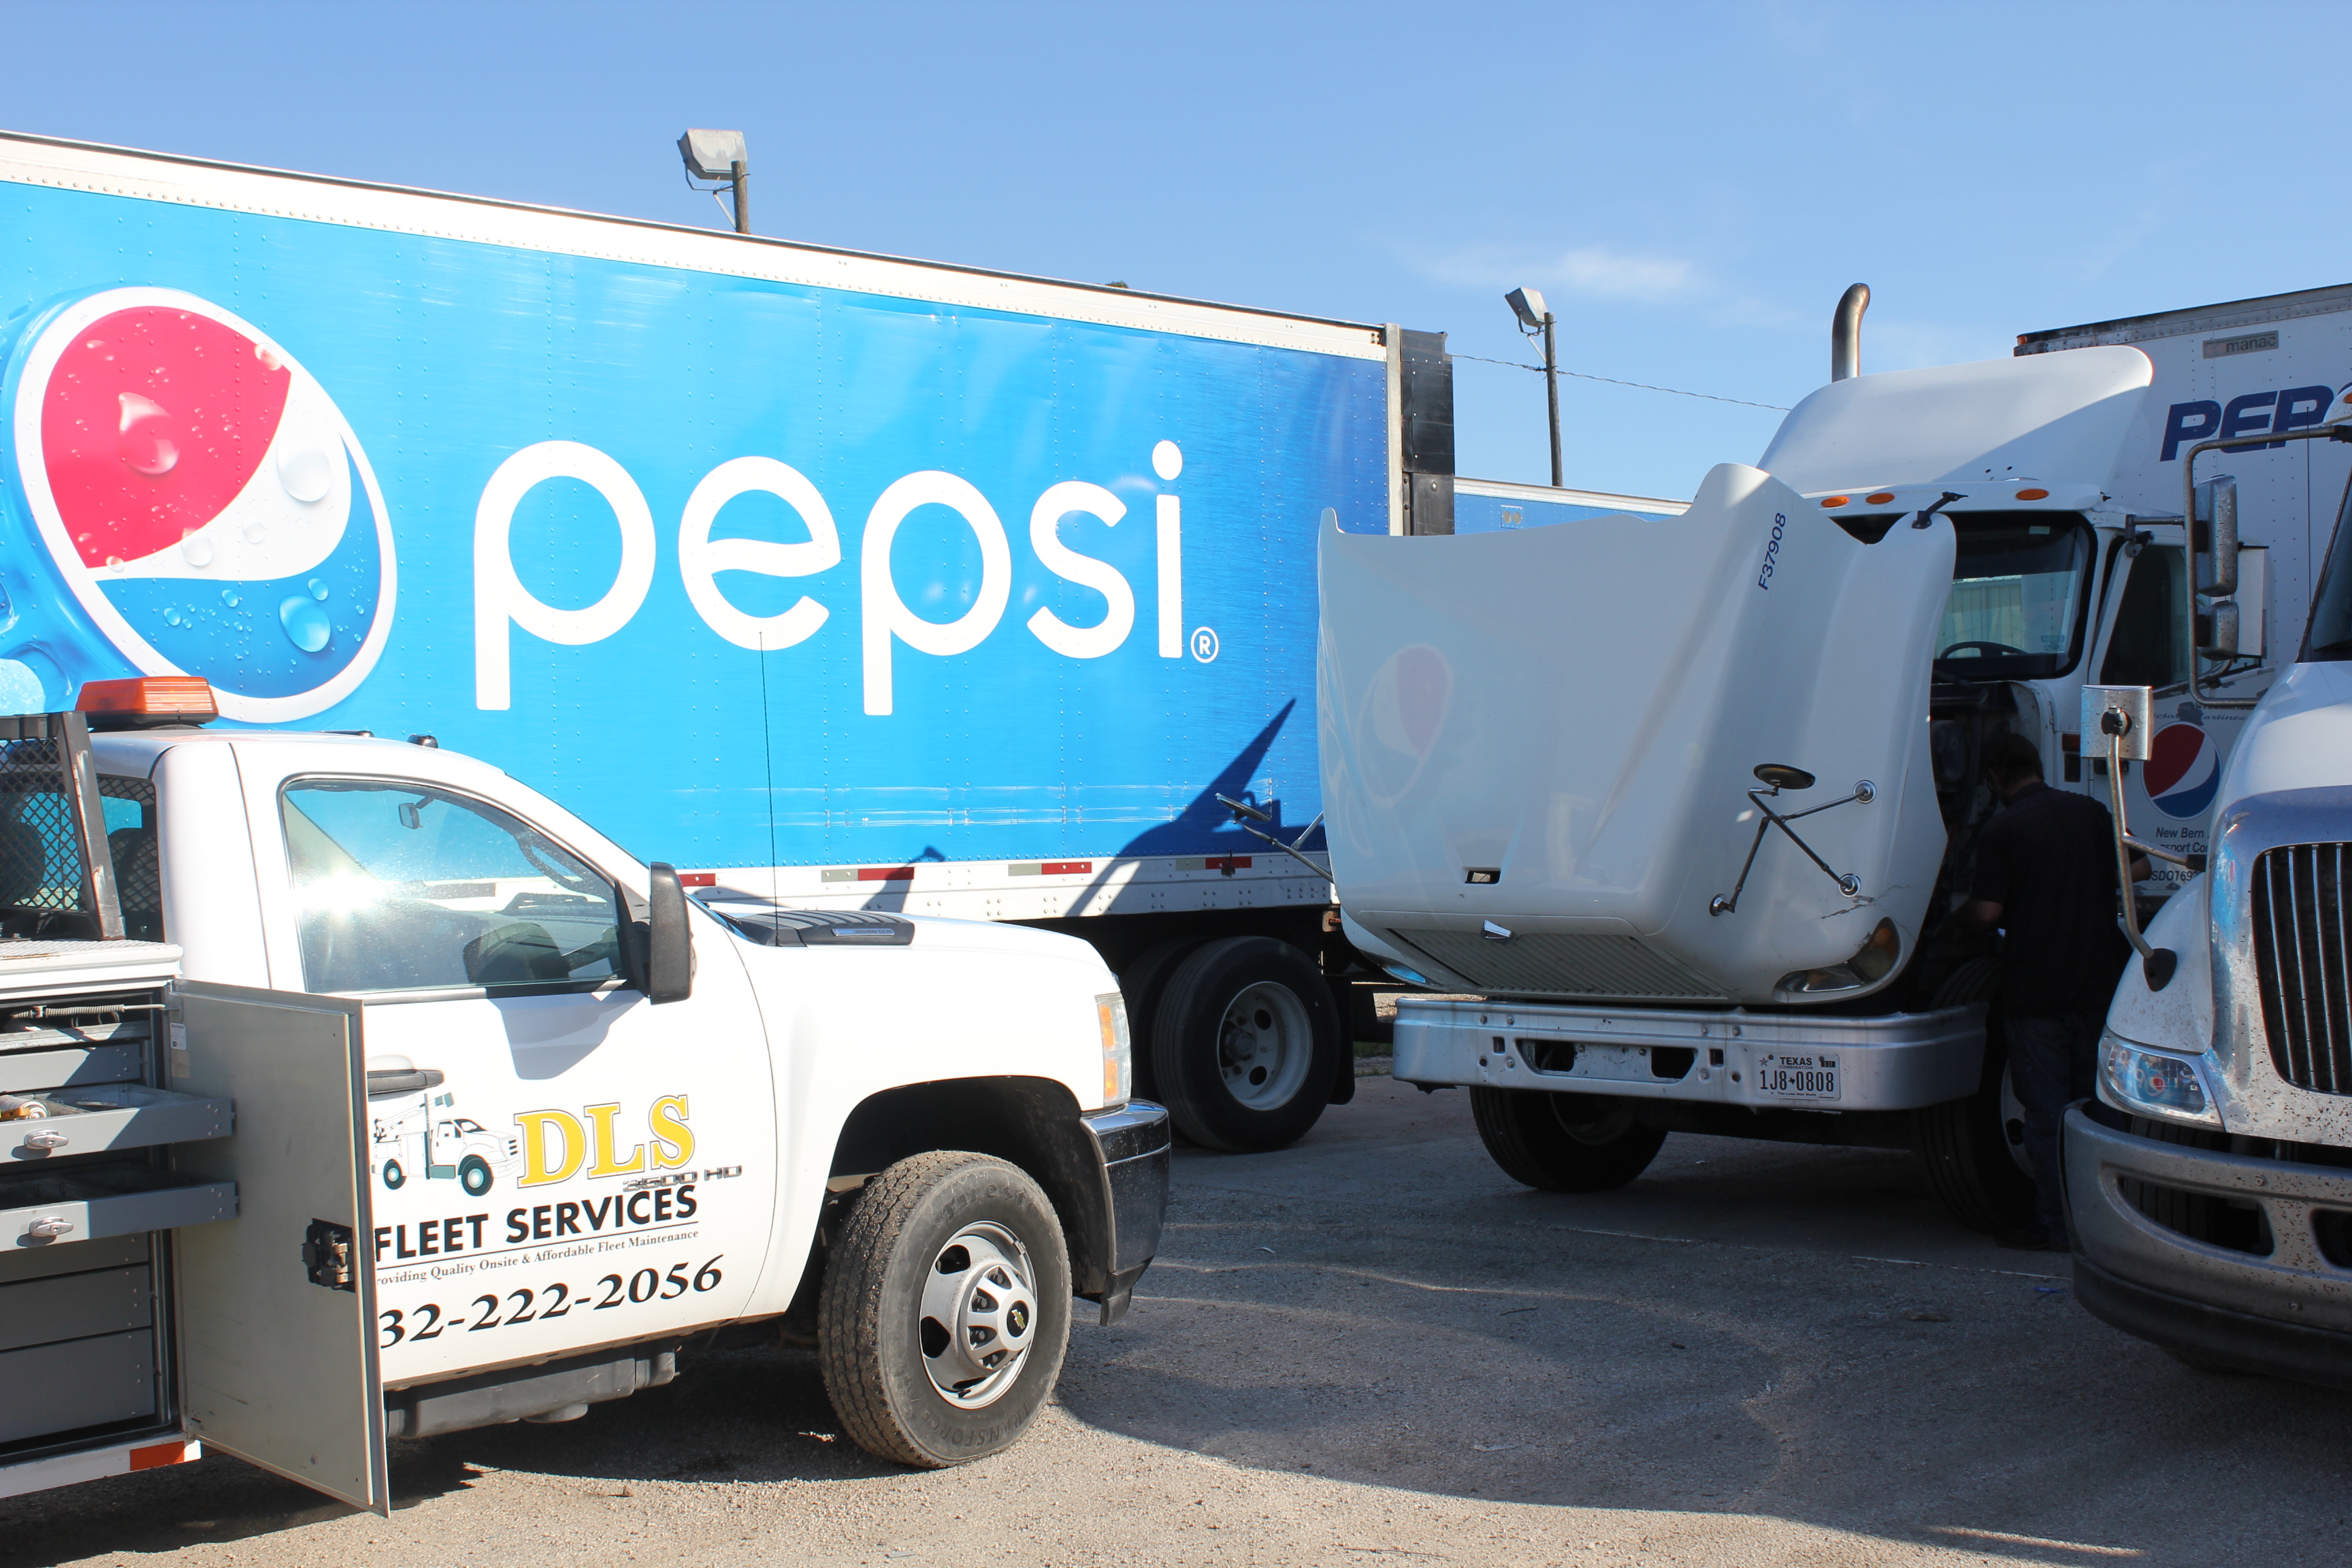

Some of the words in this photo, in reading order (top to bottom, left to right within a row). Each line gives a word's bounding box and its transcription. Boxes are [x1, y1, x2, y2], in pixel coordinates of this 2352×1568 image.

[2159, 382, 2352, 462] PEP
[474, 440, 1183, 717] pepsi
[1758, 512, 1786, 591] F37908
[2201, 712, 2246, 721] artinez
[2155, 827, 2178, 838] New
[2180, 827, 2204, 838] Bern
[2192, 842, 2208, 853] Co
[1779, 1056, 1812, 1066] TEXAS
[514, 1094, 696, 1189] DLS
[623, 1170, 698, 1192] 3500
[704, 1164, 742, 1181] HD
[374, 1213, 489, 1262] FLEET
[506, 1184, 698, 1244] SERVICES
[376, 1270, 427, 1286] roviding
[431, 1263, 476, 1280] Quality
[479, 1256, 519, 1270] Onsite
[521, 1254, 531, 1264] &
[534, 1245, 595, 1262] Affordable
[598, 1240, 626, 1253] Fleet
[628, 1230, 699, 1248] Maintenance
[378, 1254, 724, 1349] 32-222-2056
